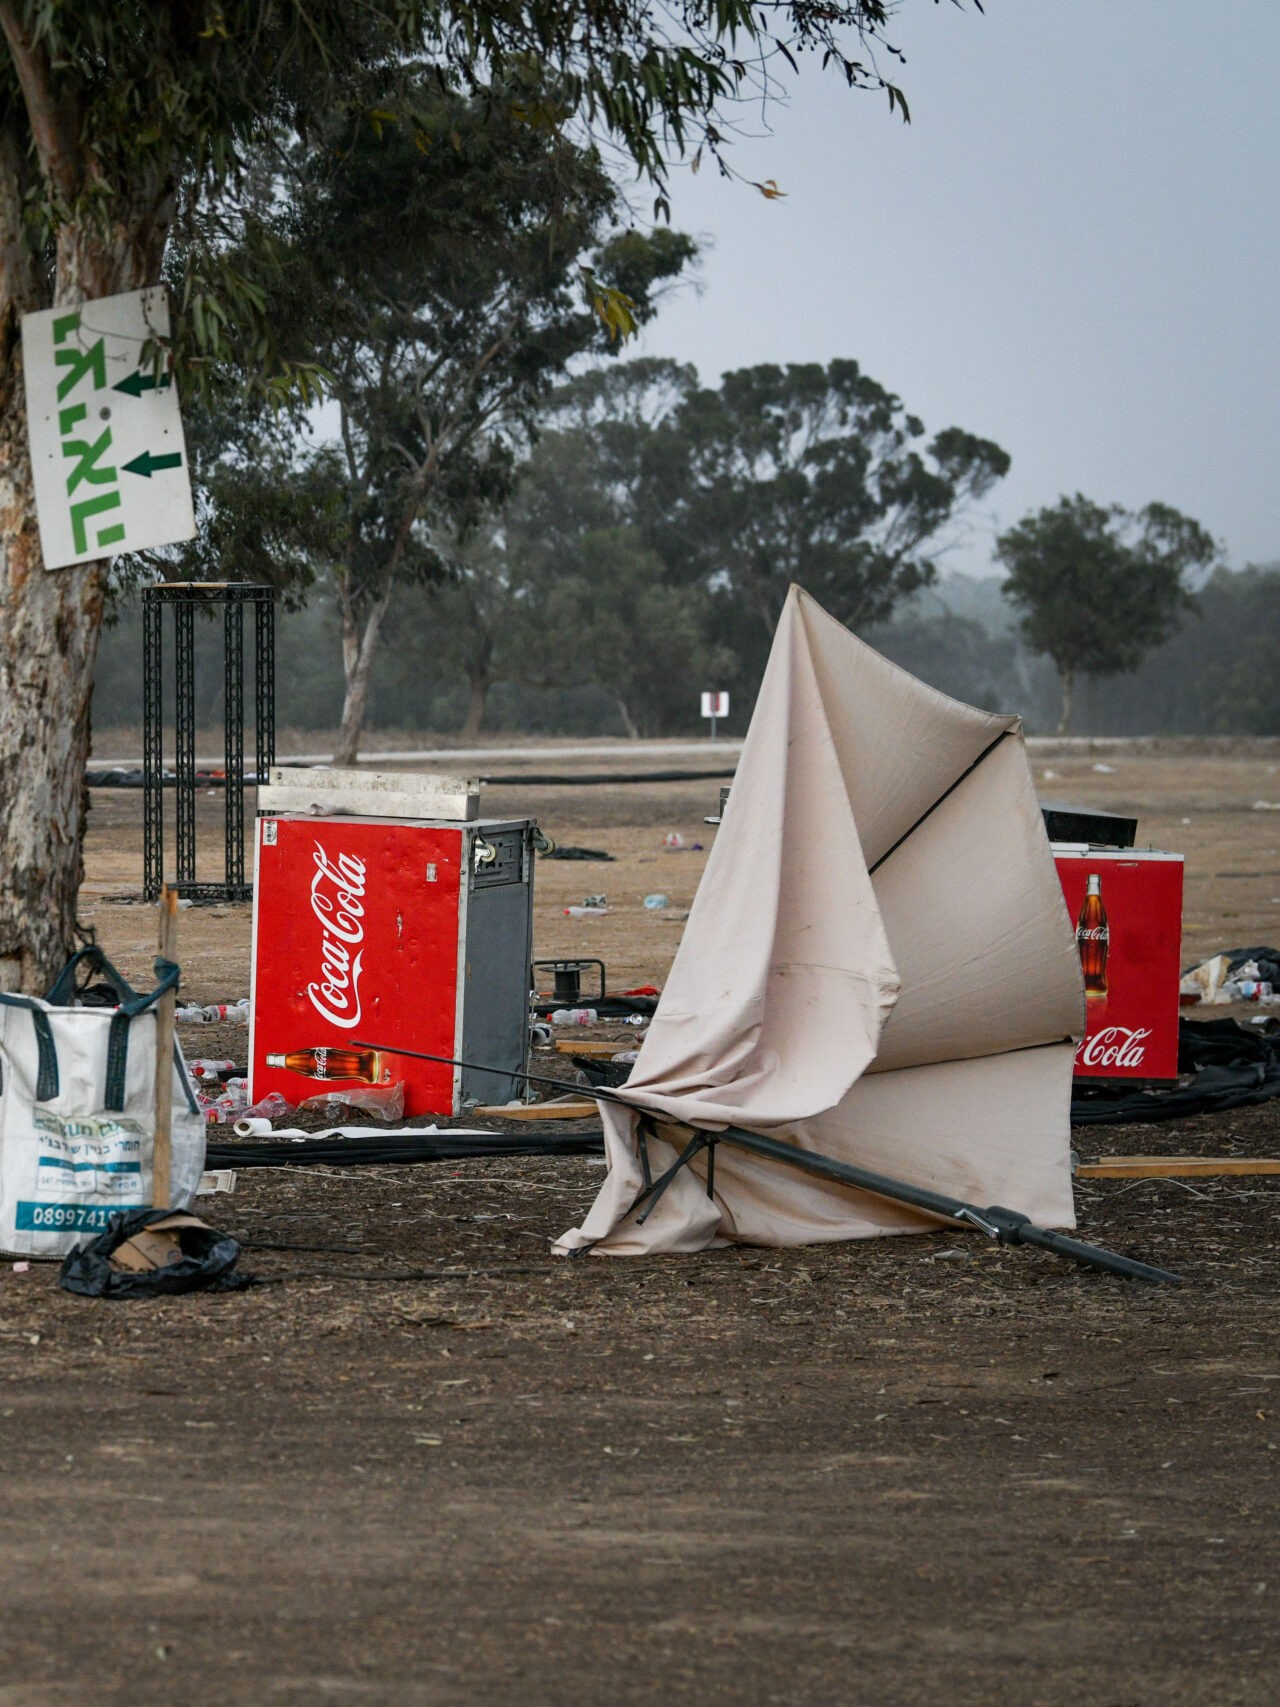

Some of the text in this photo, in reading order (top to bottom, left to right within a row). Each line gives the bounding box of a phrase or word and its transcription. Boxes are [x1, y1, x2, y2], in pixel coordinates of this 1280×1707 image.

[52, 311, 125, 555] יציאה
[307, 840, 366, 1029] Coca-Cola
[1074, 1026, 1153, 1068] -Cola
